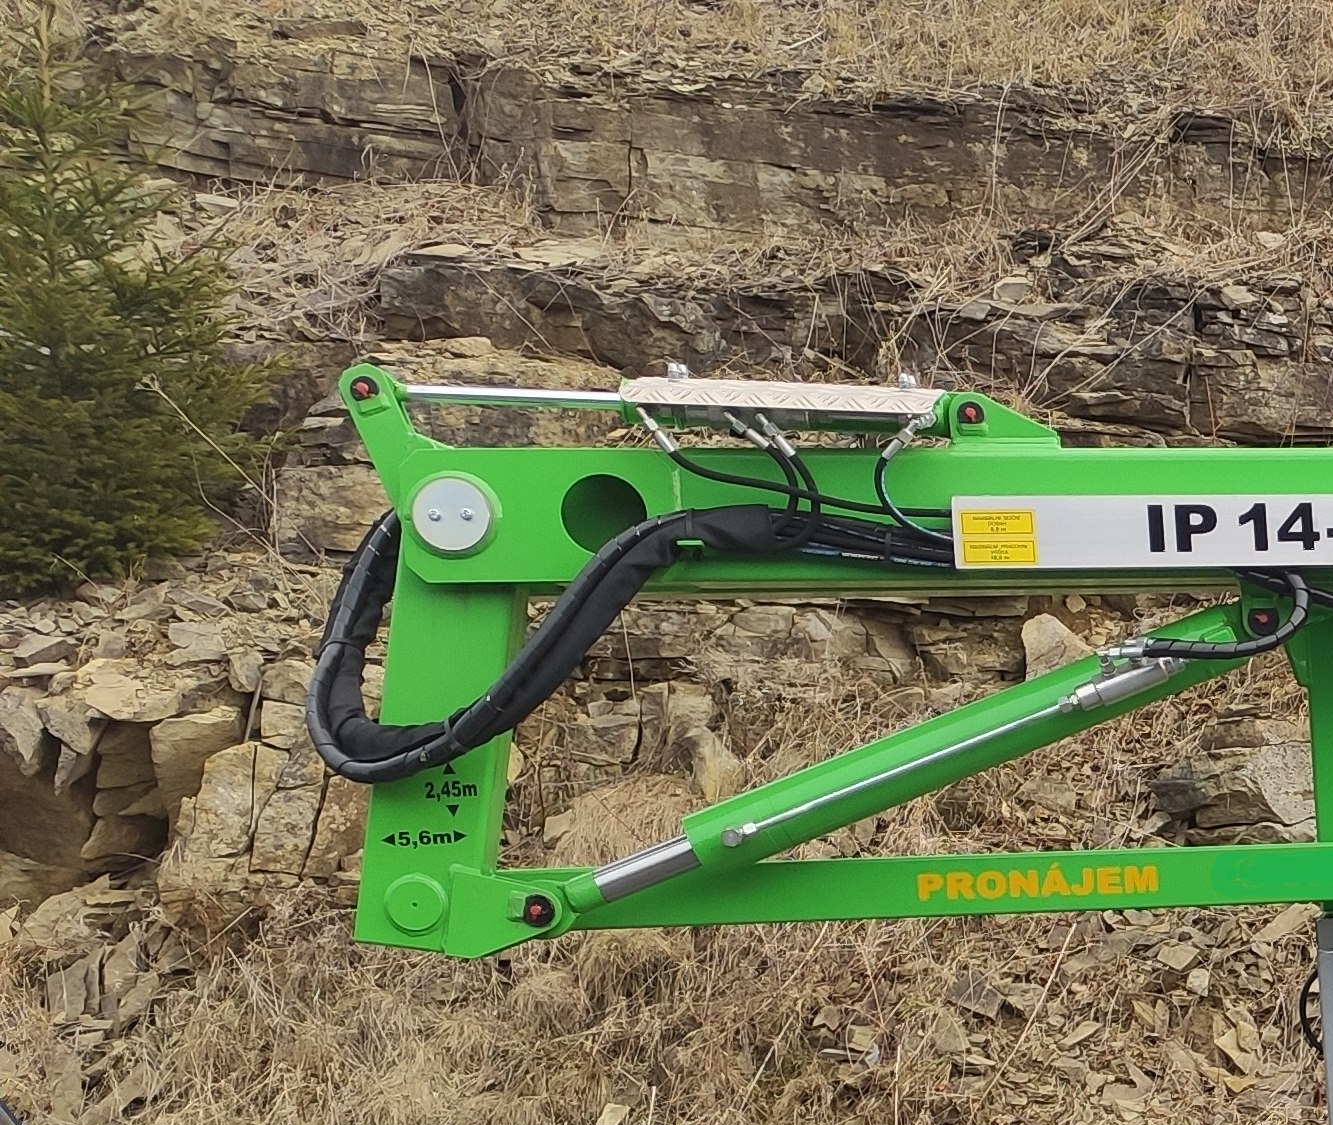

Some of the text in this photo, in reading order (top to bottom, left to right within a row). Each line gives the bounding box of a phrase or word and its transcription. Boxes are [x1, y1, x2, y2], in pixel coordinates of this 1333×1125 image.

[1146, 503, 1218, 553] IP
[424, 780, 478, 802] 2,45m
[397, 830, 453, 850] 5,6m
[916, 862, 1160, 902] PRONÁJEM
